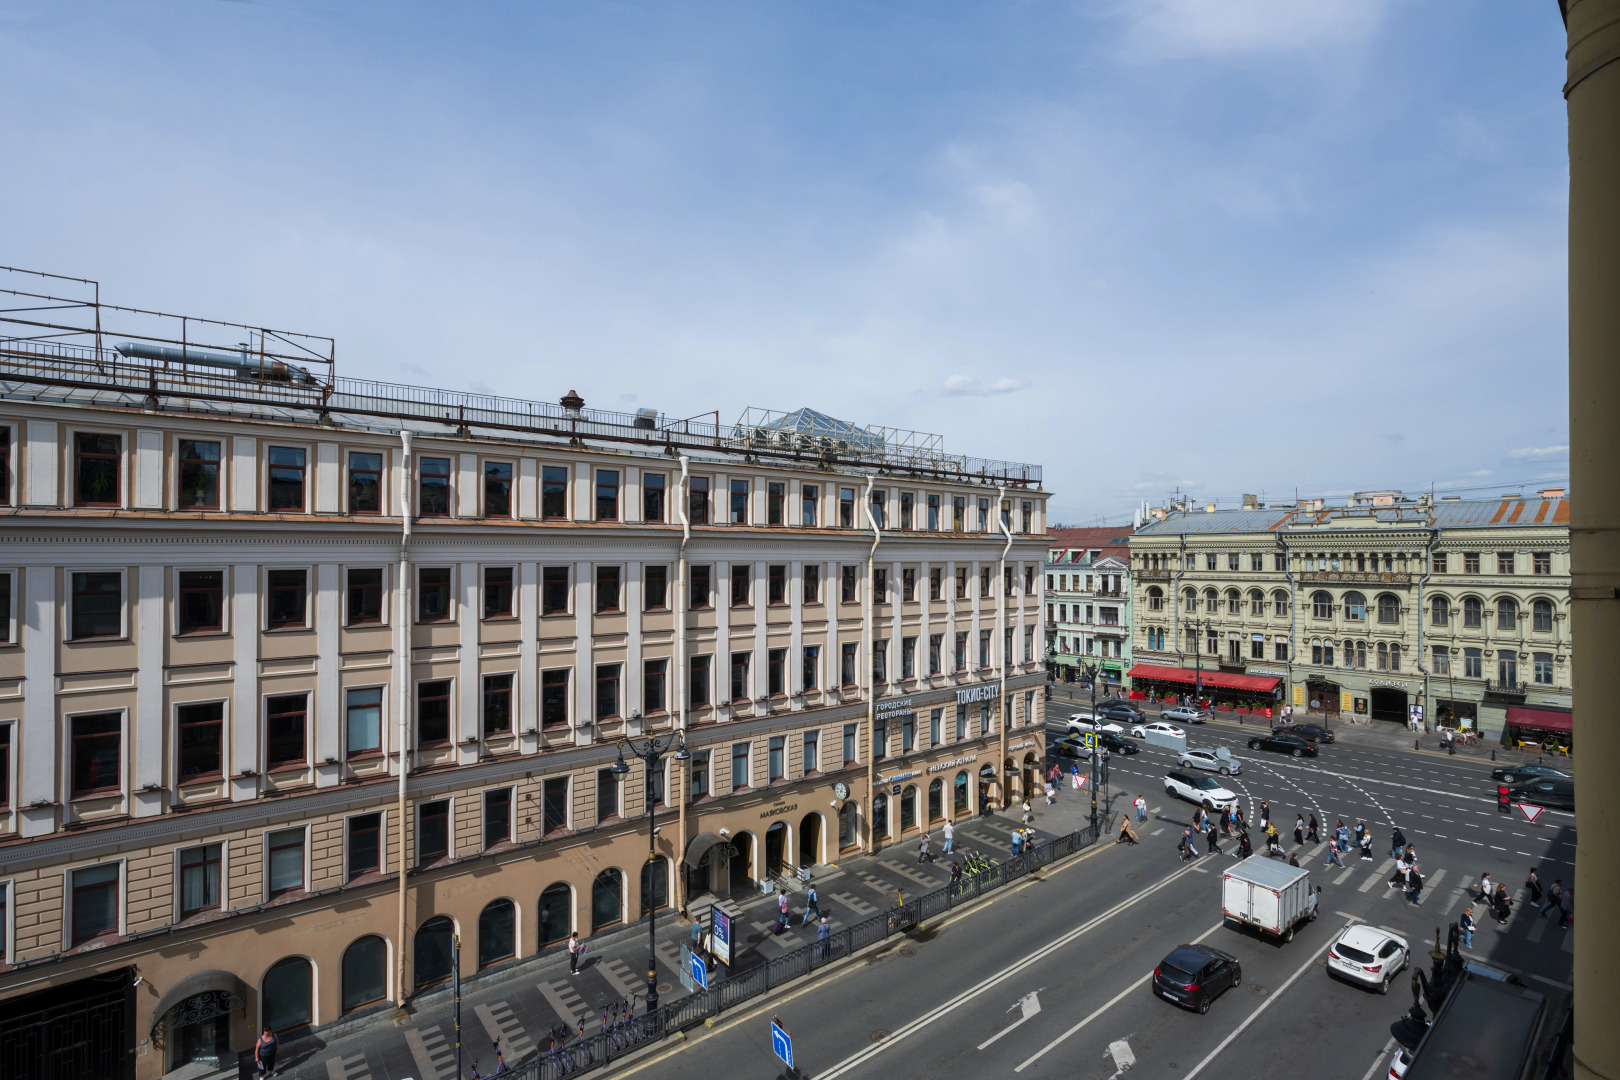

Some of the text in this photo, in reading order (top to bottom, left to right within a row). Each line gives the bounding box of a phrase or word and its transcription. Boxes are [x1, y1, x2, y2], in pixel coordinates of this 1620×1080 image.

[956, 684, 1000, 705] ТОКИО-CITY
[876, 699, 912, 711] ГОРОДСКИЕ
[876, 708, 912, 720] РЕСТОРАНЫ
[760, 803, 798, 819] МАЯКОВСКАЯ
